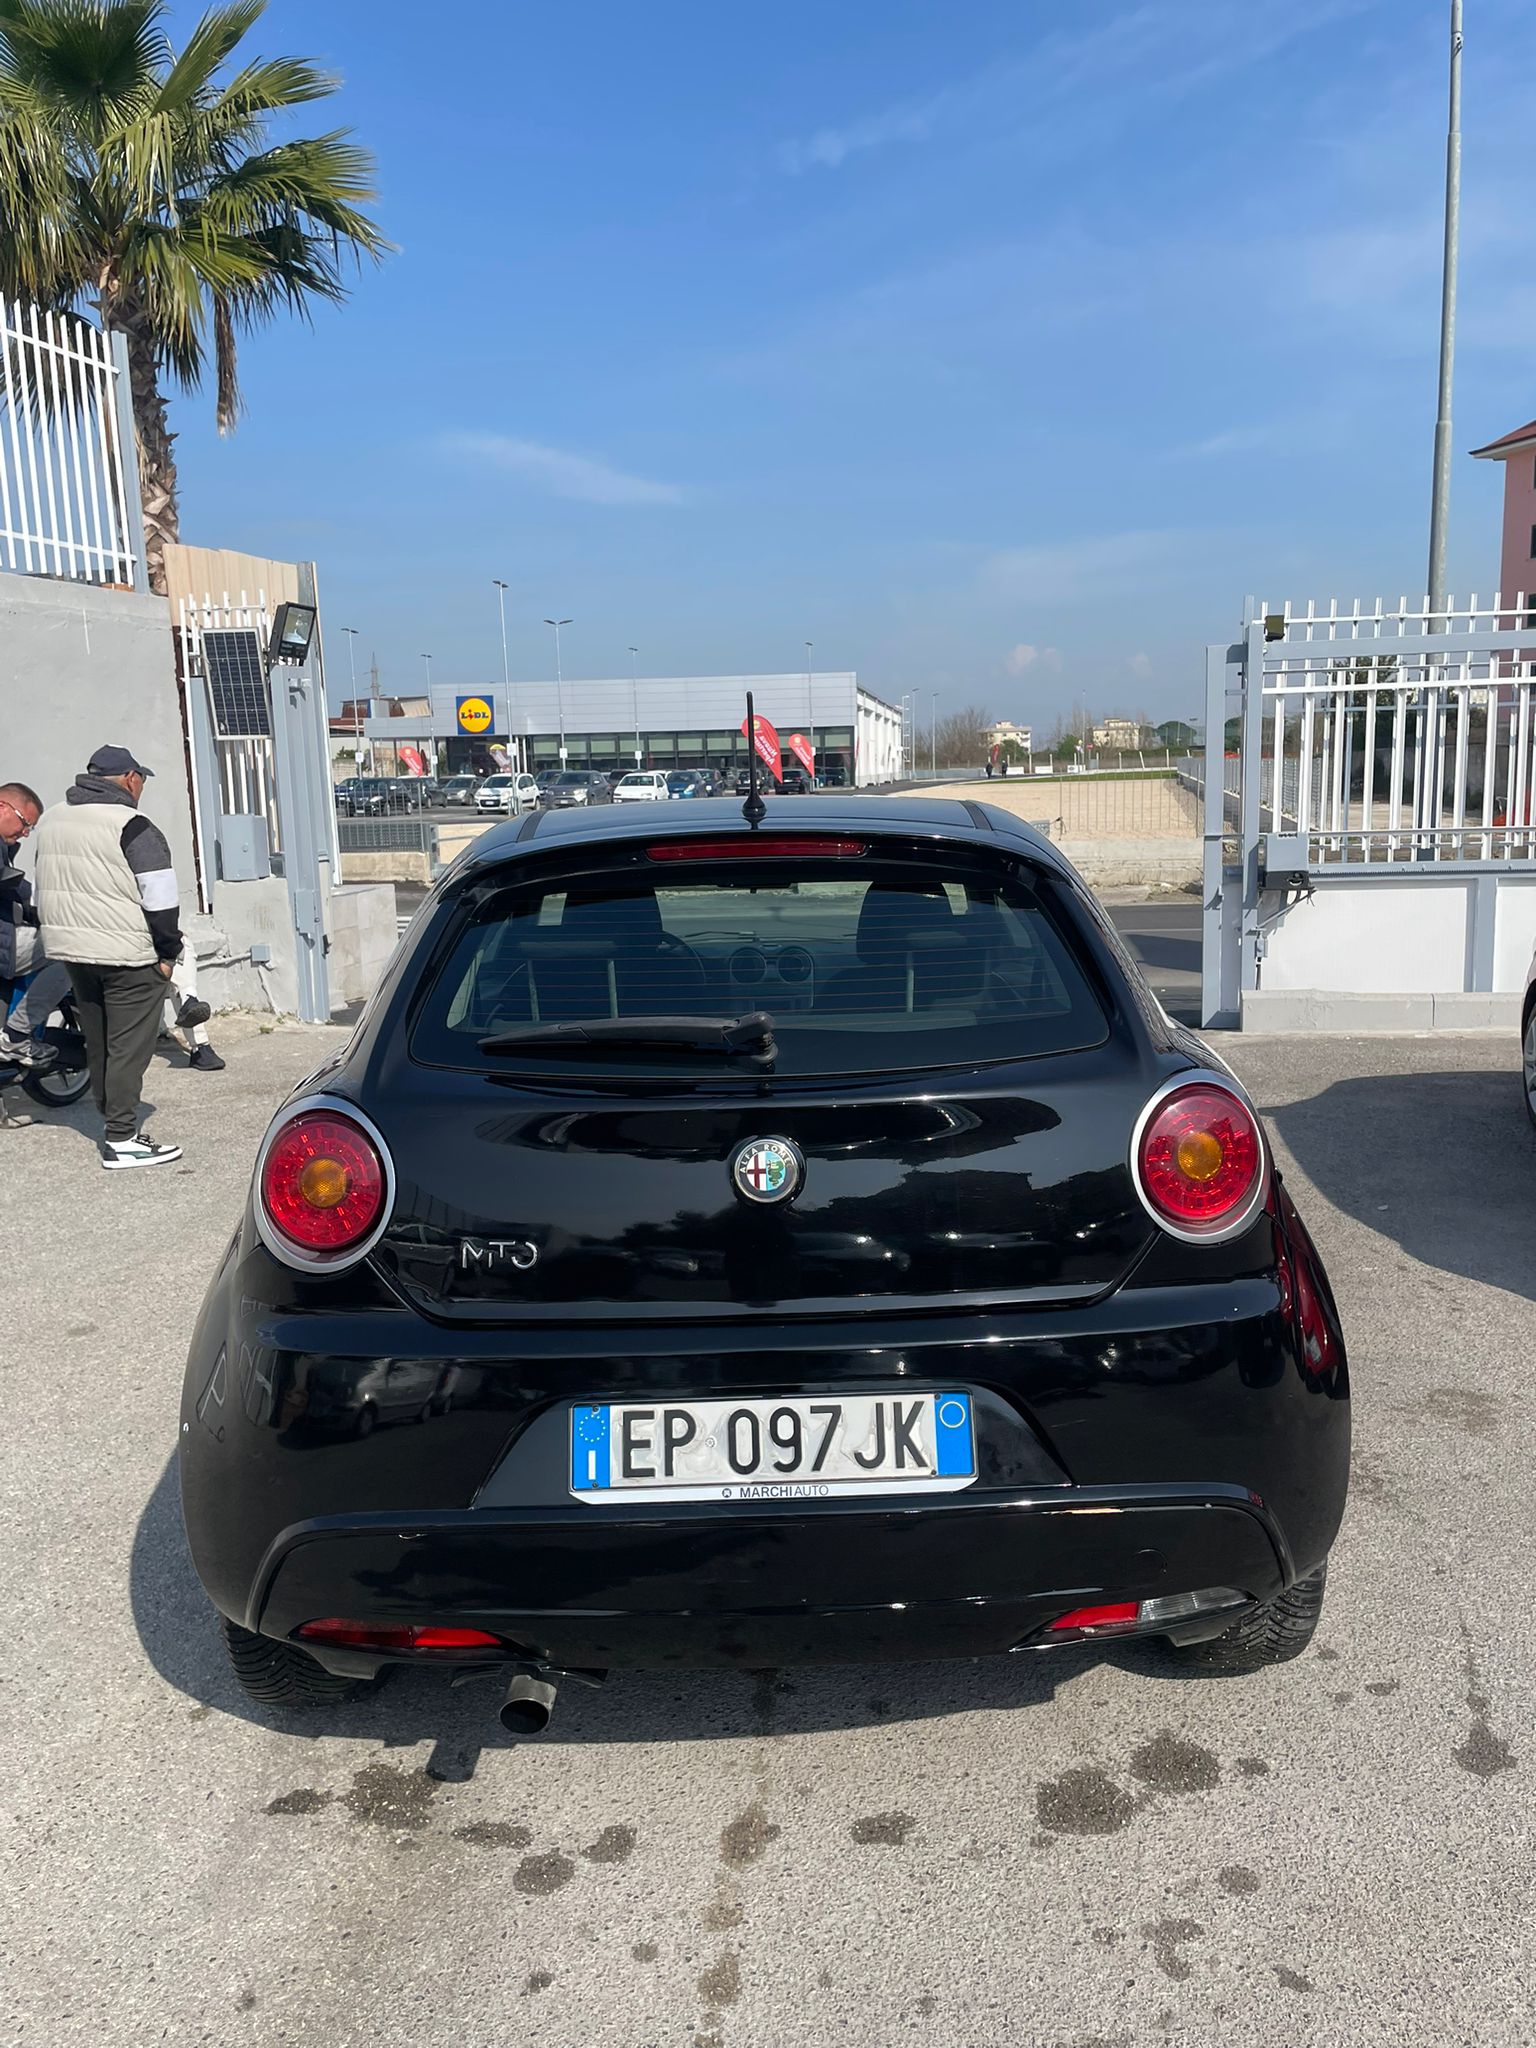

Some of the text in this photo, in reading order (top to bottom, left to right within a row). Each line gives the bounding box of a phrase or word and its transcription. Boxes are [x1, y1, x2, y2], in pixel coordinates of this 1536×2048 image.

[739, 1147, 759, 1174] ALFA
[622, 1400, 930, 1479] EP 097 JK
